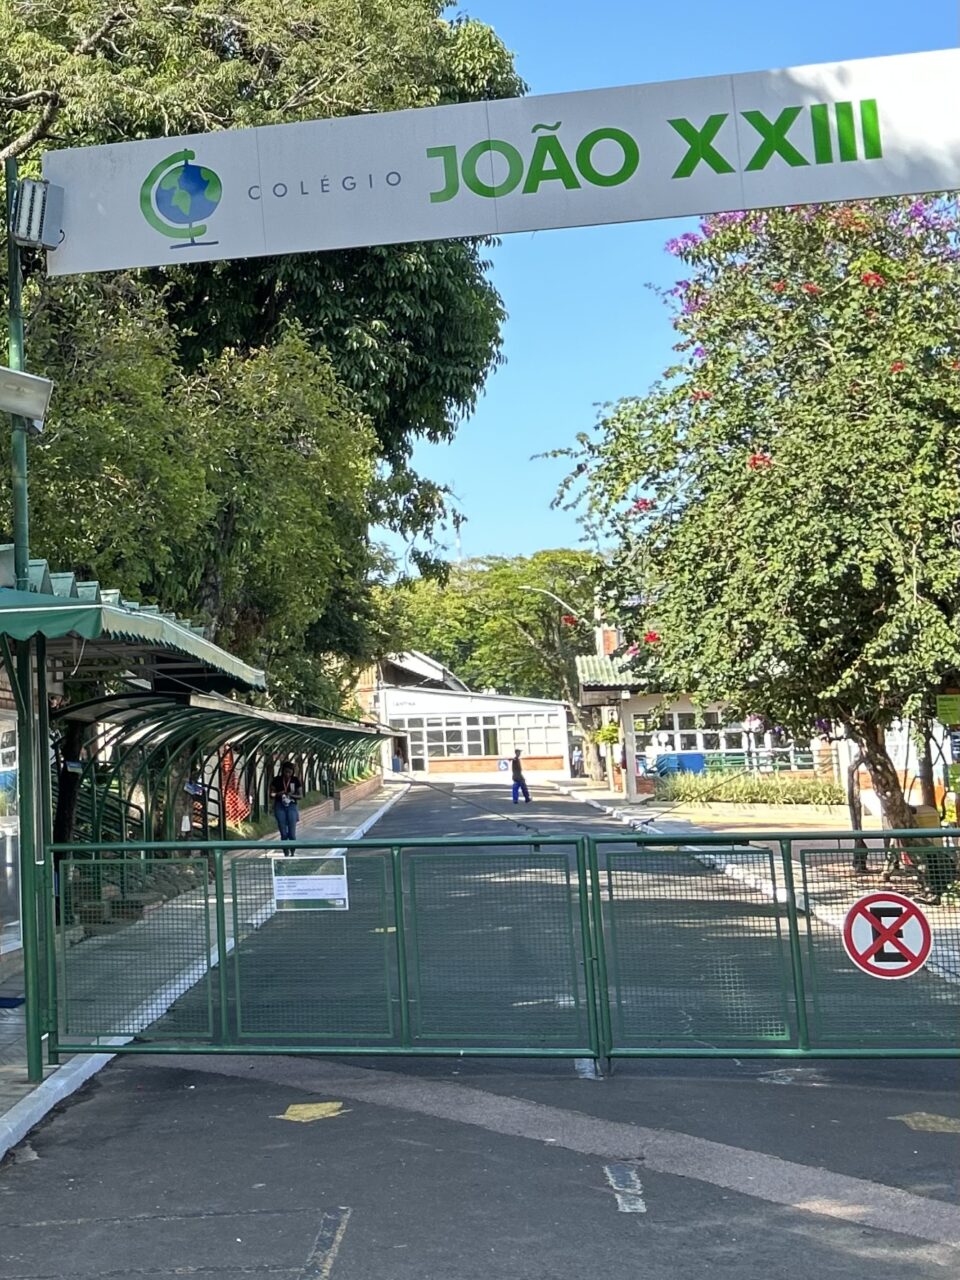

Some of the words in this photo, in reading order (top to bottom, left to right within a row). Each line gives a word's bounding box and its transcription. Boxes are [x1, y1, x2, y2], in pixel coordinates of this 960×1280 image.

[247, 170, 405, 202] COLÉGIO
[426, 121, 640, 204] JOÃO
[667, 98, 883, 180] XXIII
